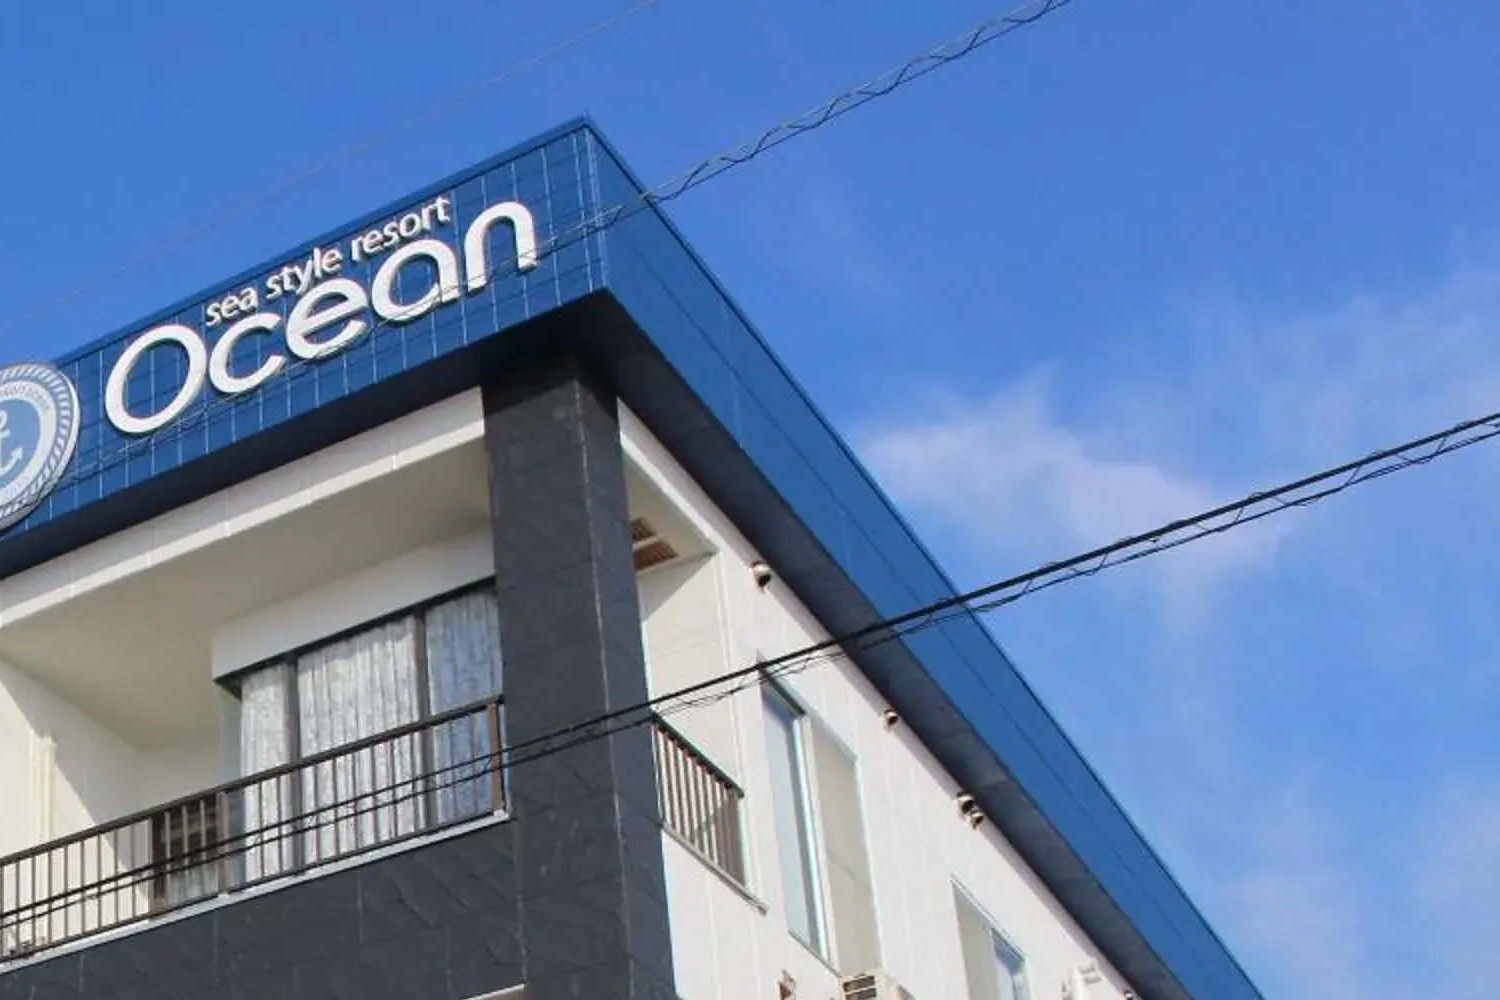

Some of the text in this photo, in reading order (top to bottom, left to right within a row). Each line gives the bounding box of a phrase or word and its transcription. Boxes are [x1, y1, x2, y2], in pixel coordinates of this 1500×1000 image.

[104, 201, 537, 434] Ocean
[205, 197, 451, 326] sea style resort
